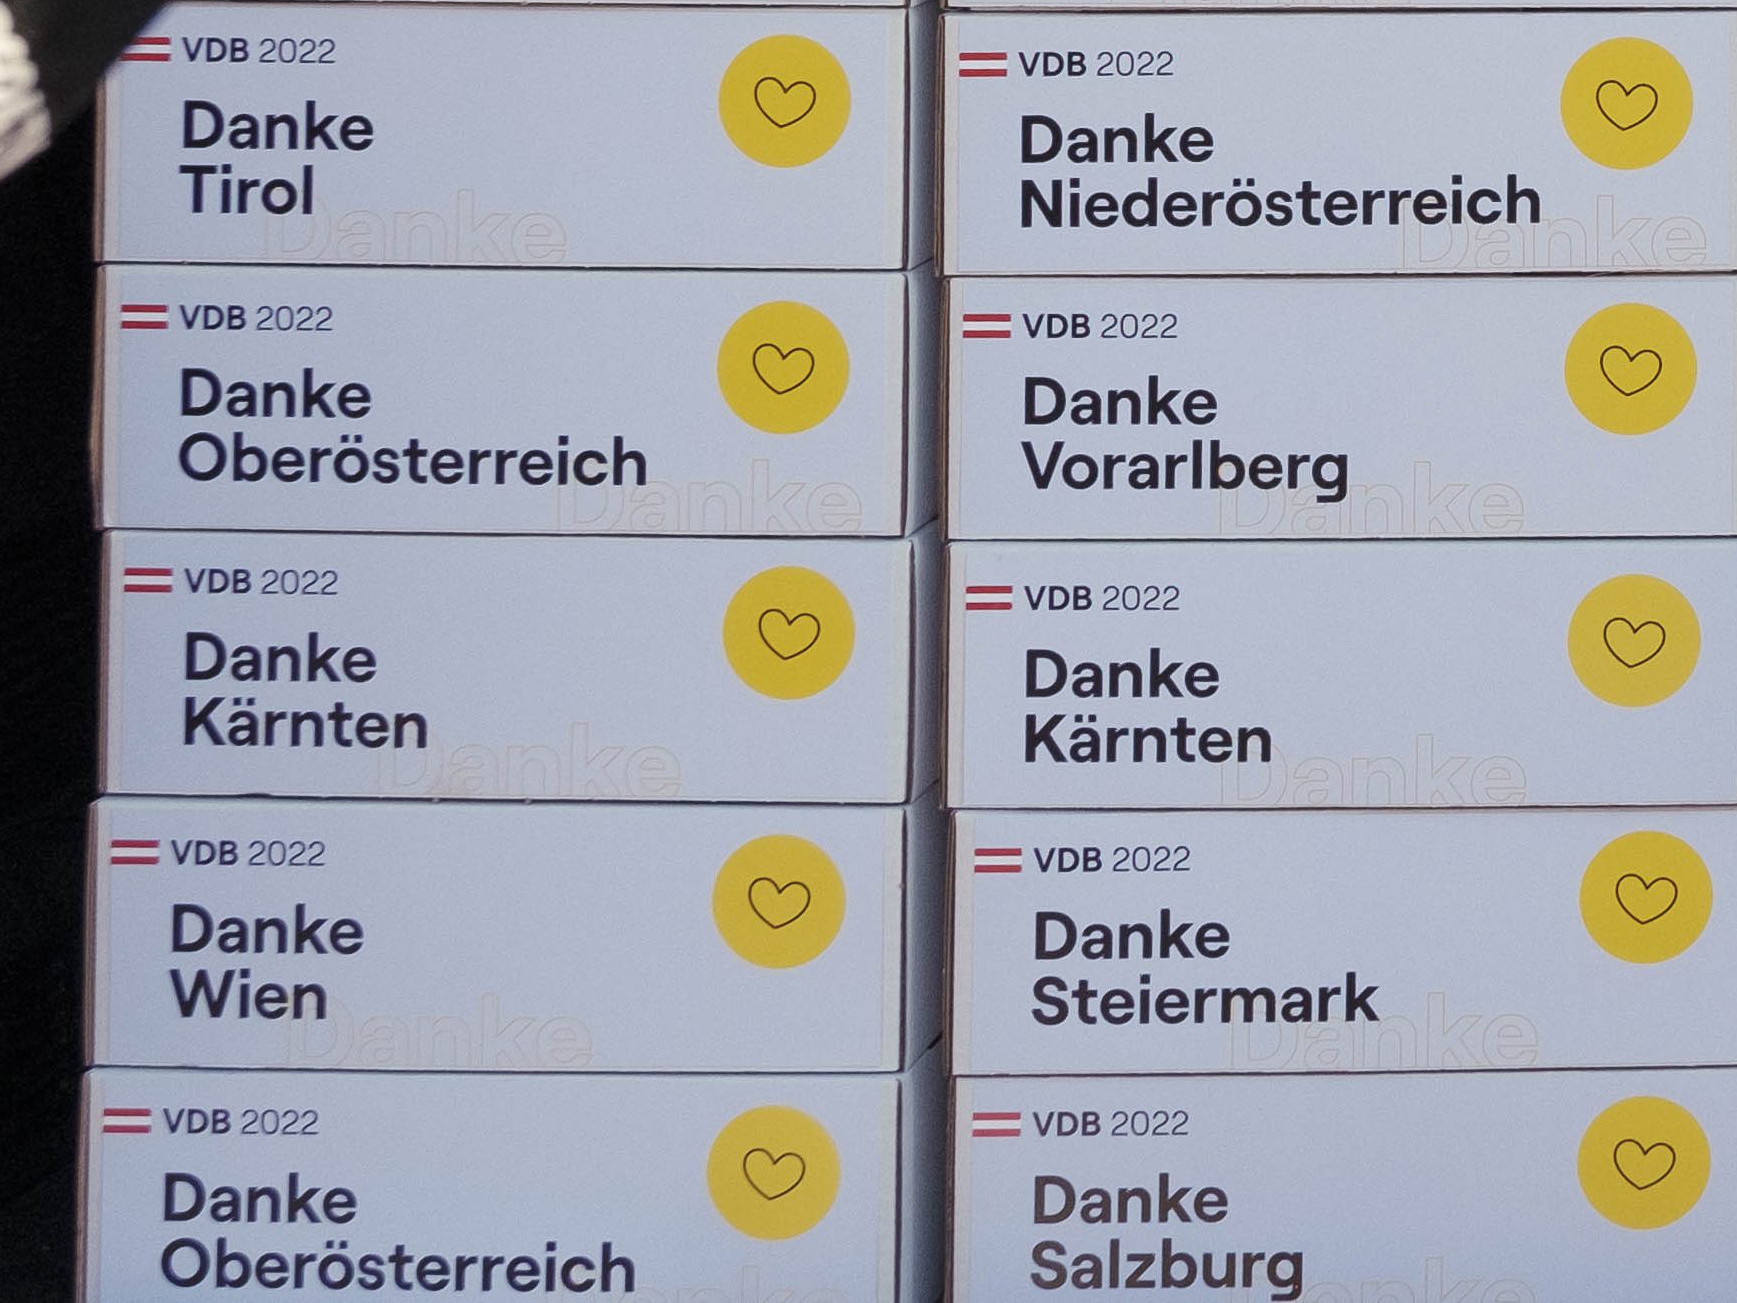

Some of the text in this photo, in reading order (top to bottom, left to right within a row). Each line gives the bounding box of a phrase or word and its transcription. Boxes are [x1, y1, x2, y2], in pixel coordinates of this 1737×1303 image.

[182, 37, 335, 63] VDB 2022
[1019, 51, 1173, 76] VDB 2022
[184, 100, 373, 151] Danke
[1022, 113, 1213, 163] Danke
[179, 164, 312, 214] Tirol
[1022, 174, 1540, 227] Niederösterreich
[180, 305, 332, 331] VDB 2022
[1023, 314, 1177, 338] VDB 2022
[181, 368, 370, 418] Danke
[1025, 375, 1217, 425] Danke
[179, 432, 646, 485] Oberösterreich
[1021, 440, 1347, 503] Vorarlberg
[184, 568, 337, 595] VDB 2022
[1025, 586, 1179, 610] VDB 2022
[186, 632, 376, 682] Danke
[1026, 648, 1219, 698] Danke
[184, 697, 427, 748] Kärnten
[1025, 714, 1271, 763] Kärnten
[171, 840, 325, 866] VDB 2022
[1034, 846, 1190, 872] VDB 2022
[172, 904, 363, 954] Danke
[1035, 909, 1229, 960] Danke
[170, 969, 326, 1019] Wien
[1032, 972, 1379, 1025] Steiermark
[163, 1108, 318, 1135] VDB 2022
[1033, 1110, 1188, 1136] VDB 2022
[164, 1173, 356, 1224] Danke
[1034, 1173, 1228, 1224] Danke
[161, 1237, 634, 1292] Oberösterreich
[1031, 1239, 1304, 1301] Salzburg
